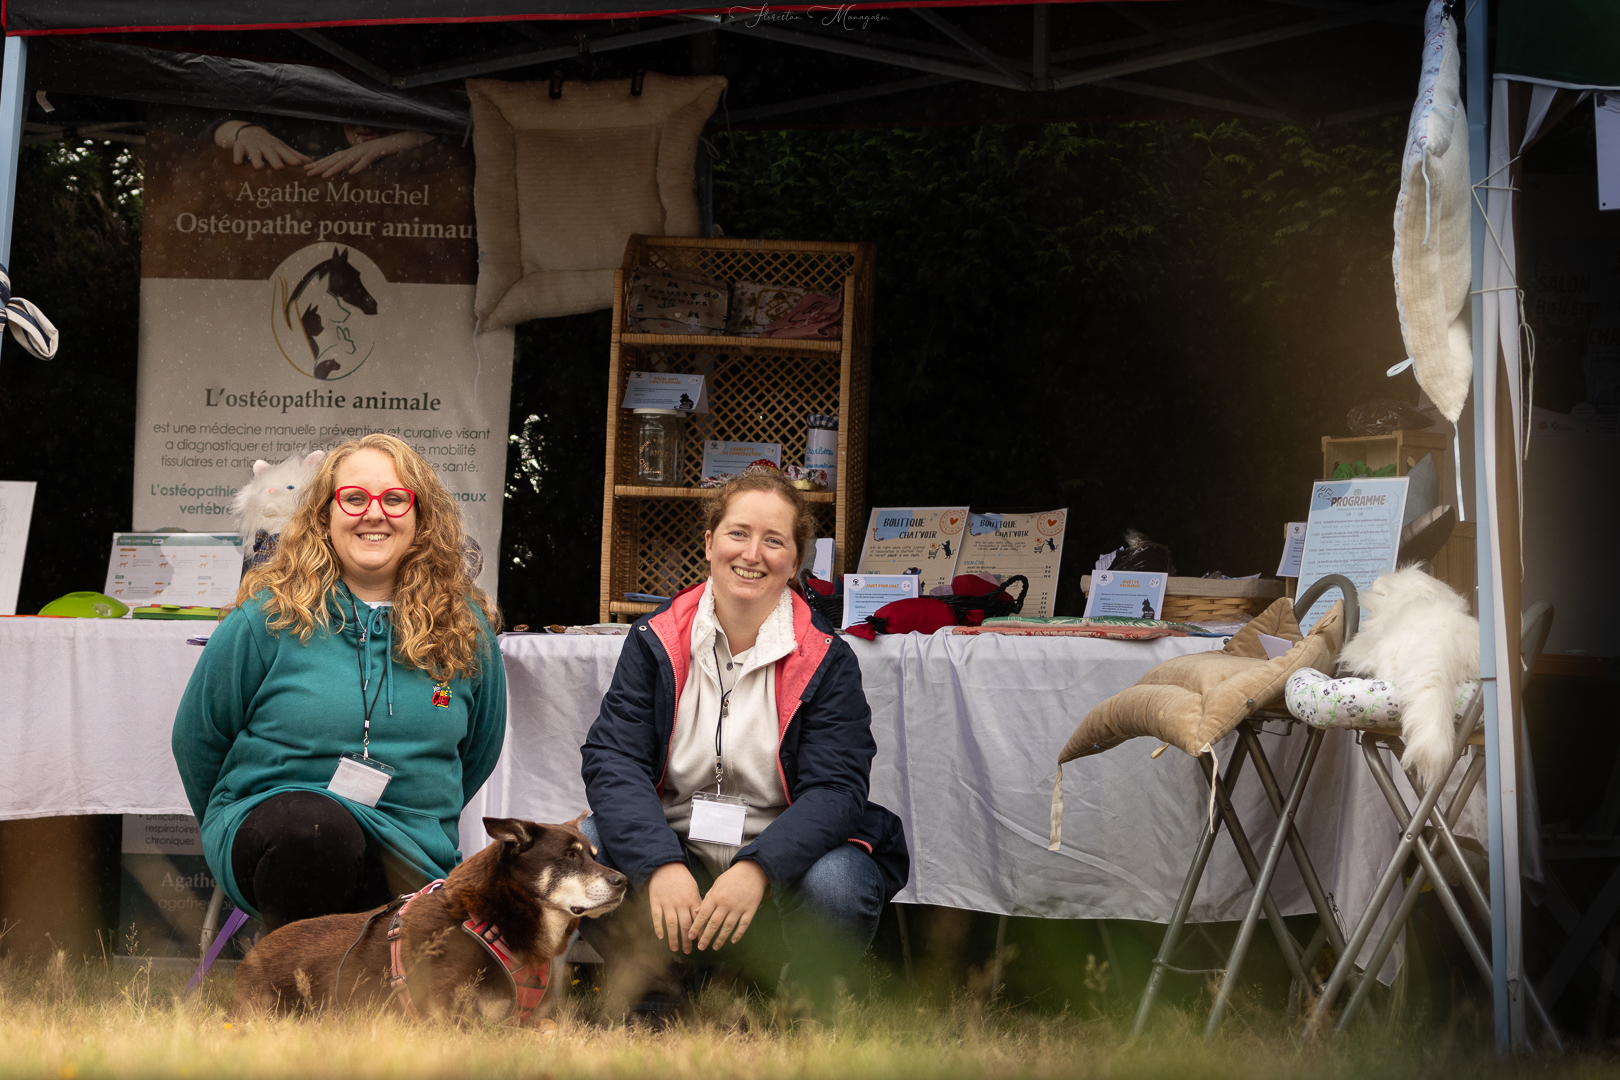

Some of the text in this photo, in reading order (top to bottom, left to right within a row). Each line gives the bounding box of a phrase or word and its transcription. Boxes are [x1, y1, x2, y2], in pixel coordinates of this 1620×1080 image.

[236, 180, 430, 208] Agathe Mouchel
[176, 212, 476, 241] Ostéopathe pour animau
[644, 284, 719, 300] Trousse de
[1538, 276, 1592, 294] SALON
[1536, 299, 1602, 316] BIEN-ÊTRE
[1588, 326, 1620, 346] CHA
[204, 388, 441, 414] L'ostéopathie animale
[153, 424, 170, 433] est
[174, 425, 196, 434] une
[200, 422, 262, 434] médecine
[264, 424, 316, 436] manuelle
[320, 424, 384, 439] préventive
[403, 427, 454, 439] curative
[456, 428, 490, 440] visant
[176, 440, 260, 454] diagnostiquer
[262, 442, 273, 452] et
[428, 444, 476, 456] mobilité
[161, 455, 214, 468] tissulaires
[216, 457, 228, 468] et
[442, 460, 478, 472] santé.
[151, 483, 238, 499] L'ostéopathie
[1330, 495, 1386, 507] PROGRAMME
[883, 518, 926, 527] BOUTIQUE
[980, 519, 1017, 528] BOUTIQUE
[899, 531, 937, 539] CHAT'VOIR
[145, 824, 199, 834] respiratoires
[145, 837, 194, 846] chroniques
[161, 872, 218, 891] Agathe
